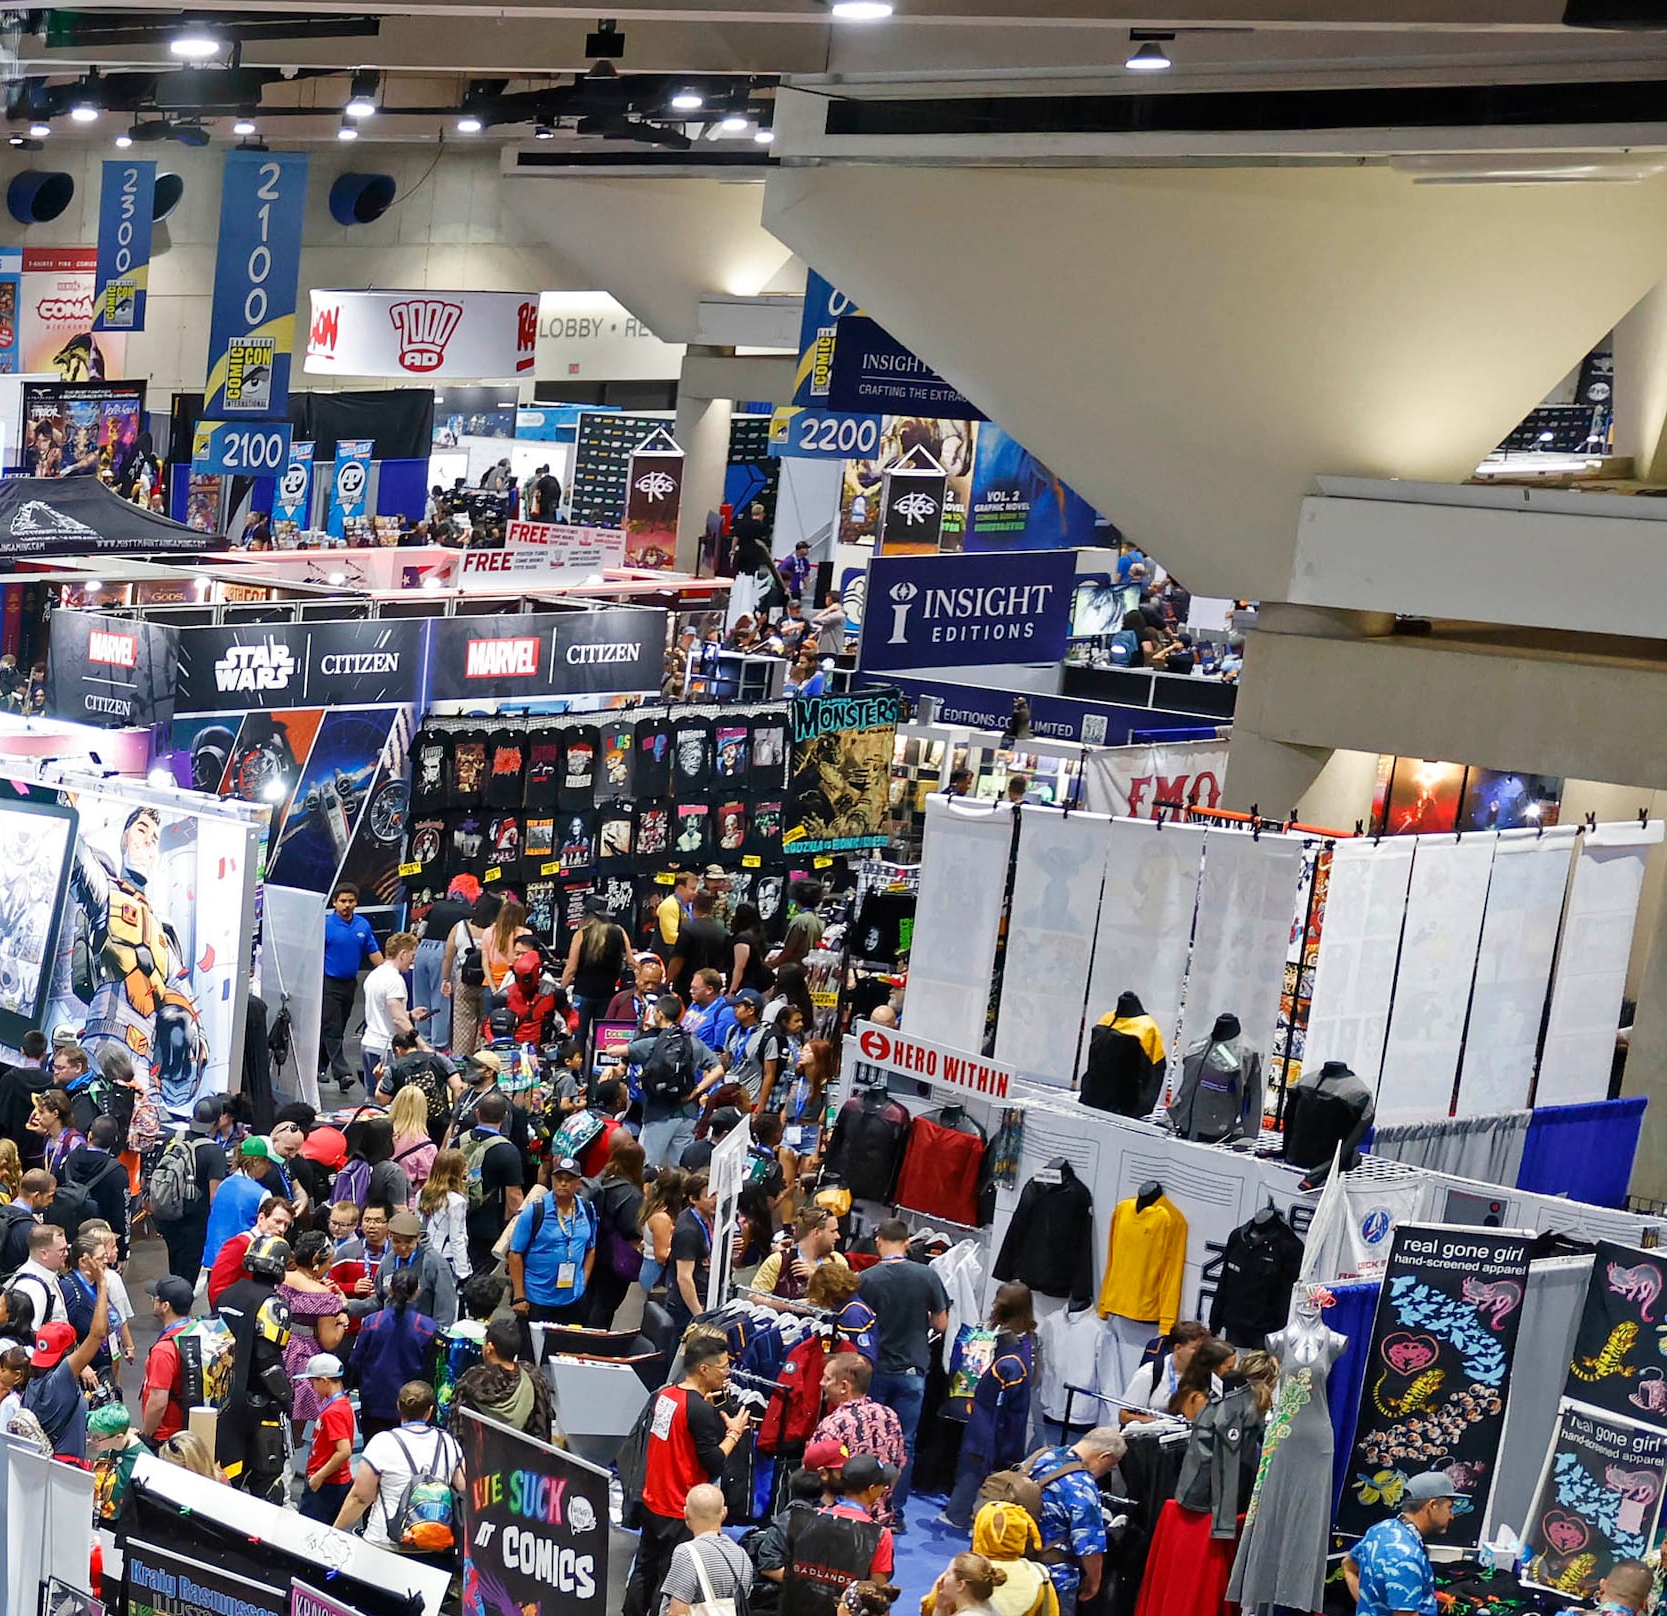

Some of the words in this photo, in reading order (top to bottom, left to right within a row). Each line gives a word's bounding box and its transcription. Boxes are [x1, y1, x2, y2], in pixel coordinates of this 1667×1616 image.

[115, 167, 138, 273] 2300
[245, 161, 280, 325] 2100
[390, 299, 462, 350] 2000
[539, 318, 603, 339] LOBBY
[243, 346, 271, 365] CON
[404, 353, 439, 369] AD
[815, 336, 831, 382] COMIC
[228, 346, 243, 400] COMIC
[227, 399, 270, 408] INTERNATIONAL
[799, 417, 876, 452] 2200
[222, 432, 283, 470] 2100
[975, 502, 1003, 512] GRAPHIC
[1005, 502, 1029, 512] NOVEL
[986, 491, 1008, 503] VOL.
[1012, 491, 1019, 502] 2
[508, 523, 548, 545] FREE
[462, 552, 513, 573] FREE
[921, 584, 1053, 618] INSIGHT
[932, 622, 1035, 642] EDITIONS
[89, 633, 136, 666] MARVEL
[216, 644, 290, 669] STAR
[321, 653, 399, 674] CITIZEN
[467, 639, 537, 678] MARVEL
[566, 642, 641, 664] CITIZEN
[215, 663, 293, 691] WARS
[84, 694, 130, 717] CITIZEN
[794, 694, 899, 742] MONSTERS
[892, 1041, 936, 1075] HERO
[942, 1056, 1008, 1098] WITHIN
[1395, 1252, 1472, 1269] hand-screened
[1475, 1259, 1526, 1277] apparel
[1403, 1239, 1438, 1255] real
[1443, 1243, 1484, 1261] gone
[1489, 1245, 1524, 1263] girl
[1561, 1429, 1619, 1462] hand-screened
[1621, 1448, 1665, 1466] apparel
[1597, 1426, 1622, 1450] gone
[1626, 1429, 1660, 1451] girl
[510, 1471, 565, 1525] SUCK
[503, 1528, 596, 1598] COMICS
[130, 1557, 176, 1598] Kraig
